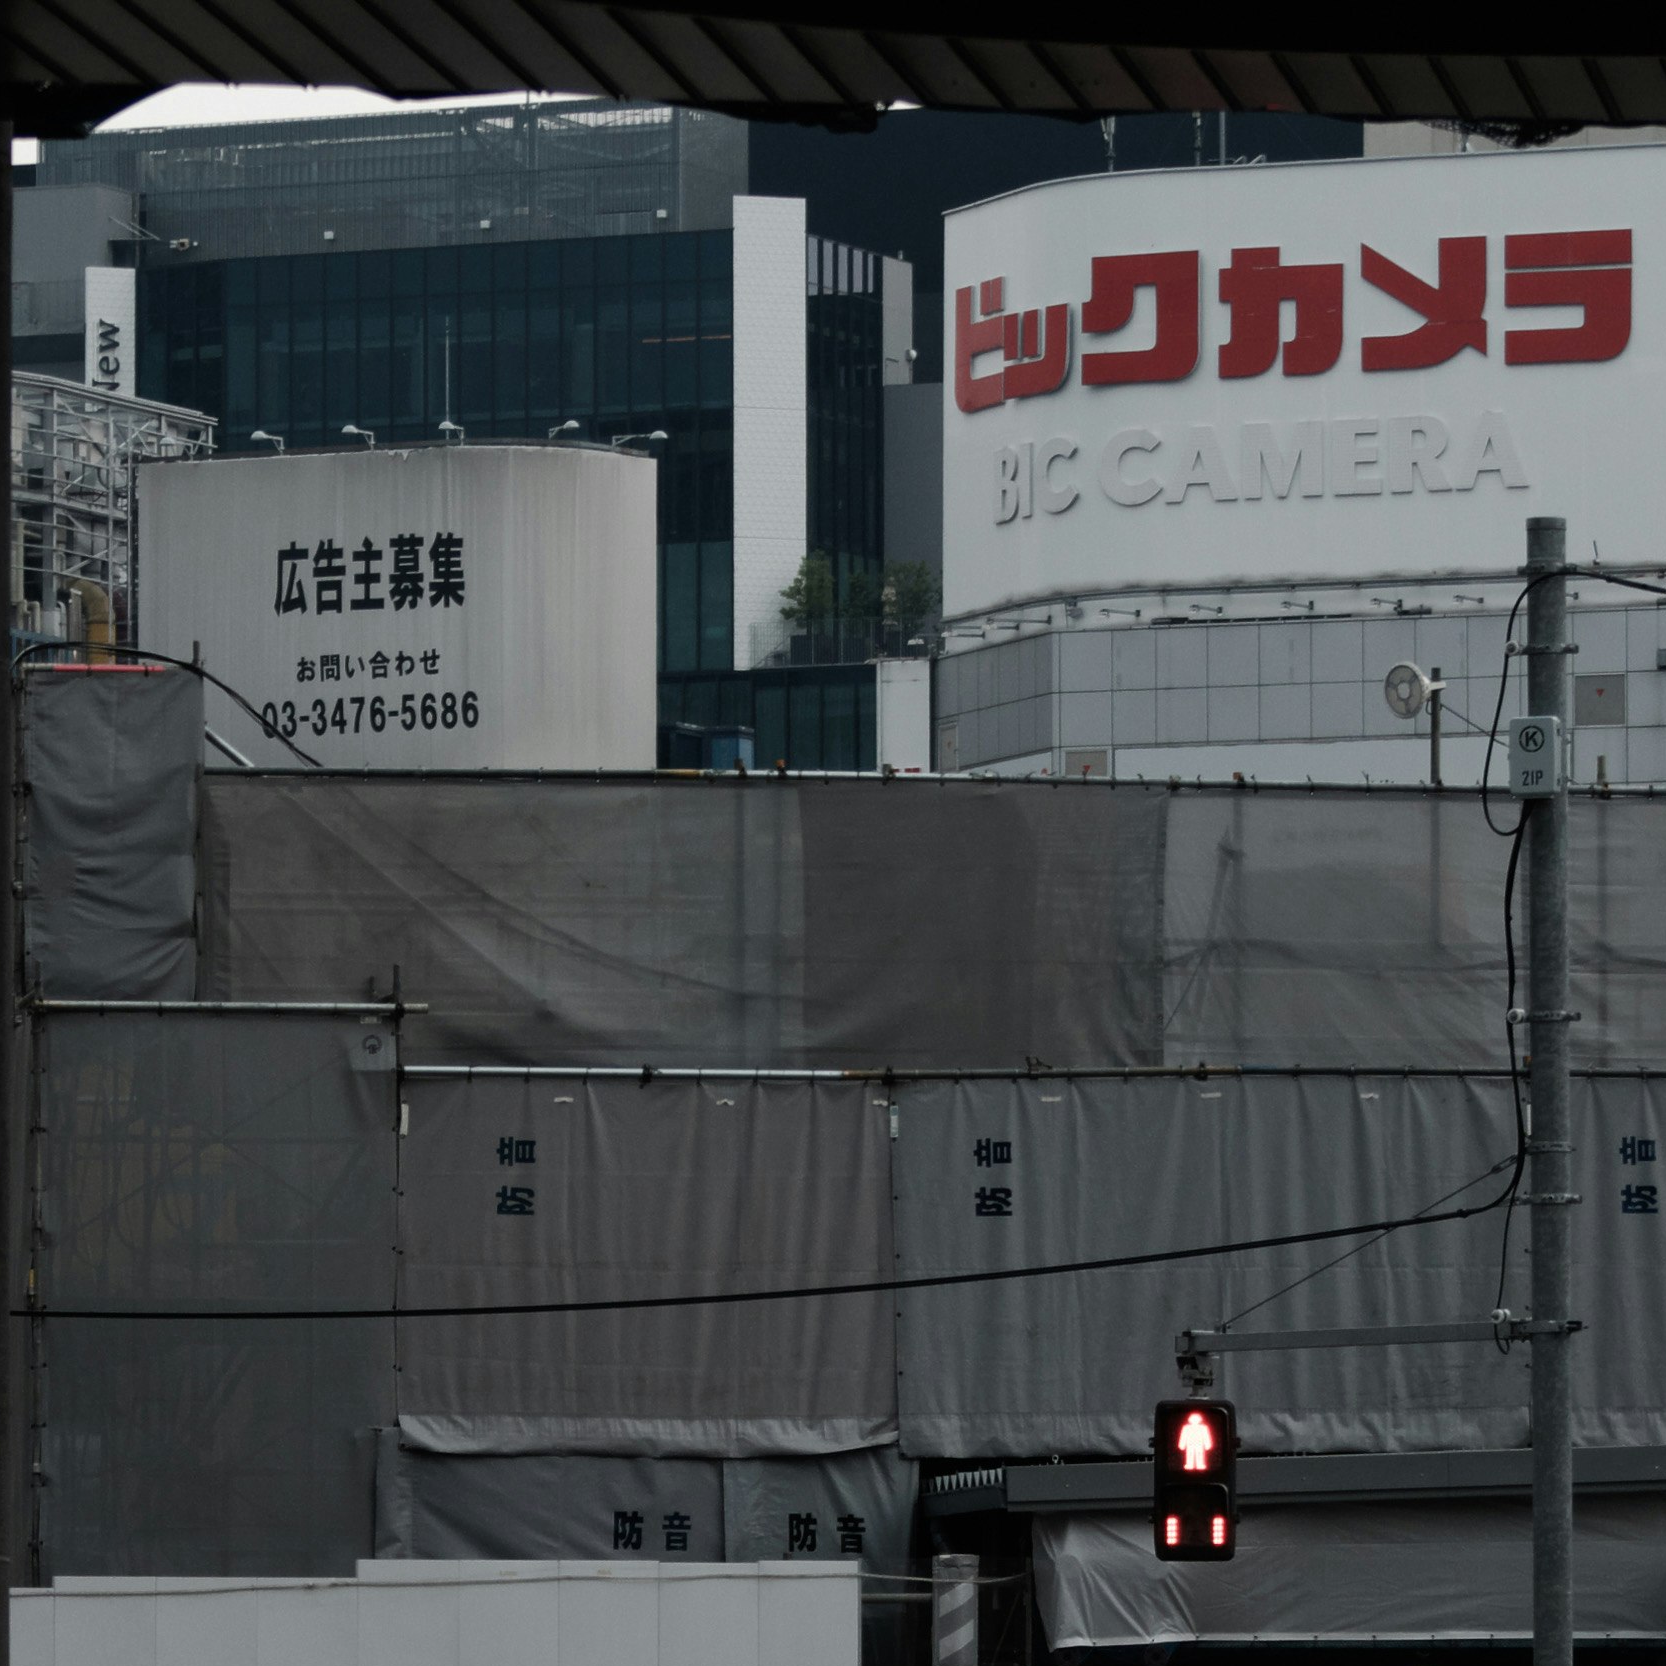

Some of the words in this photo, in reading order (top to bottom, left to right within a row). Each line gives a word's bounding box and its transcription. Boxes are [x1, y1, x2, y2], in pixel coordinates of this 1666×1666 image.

[954, 228, 1634, 414] ビックカメラ
[993, 435, 1081, 526] BIC
[1098, 411, 1529, 508] CAMERA
[273, 531, 466, 617] 広告主募集
[295, 648, 441, 684] お問い合わせ
[262, 690, 480, 740] 03-3476-5686
[496, 1136, 537, 1217] 防音
[974, 1137, 1013, 1217] 防音
[1619, 1135, 1658, 1215] 防音
[612, 1509, 692, 1553] 防音
[788, 1511, 866, 1554] 防音
